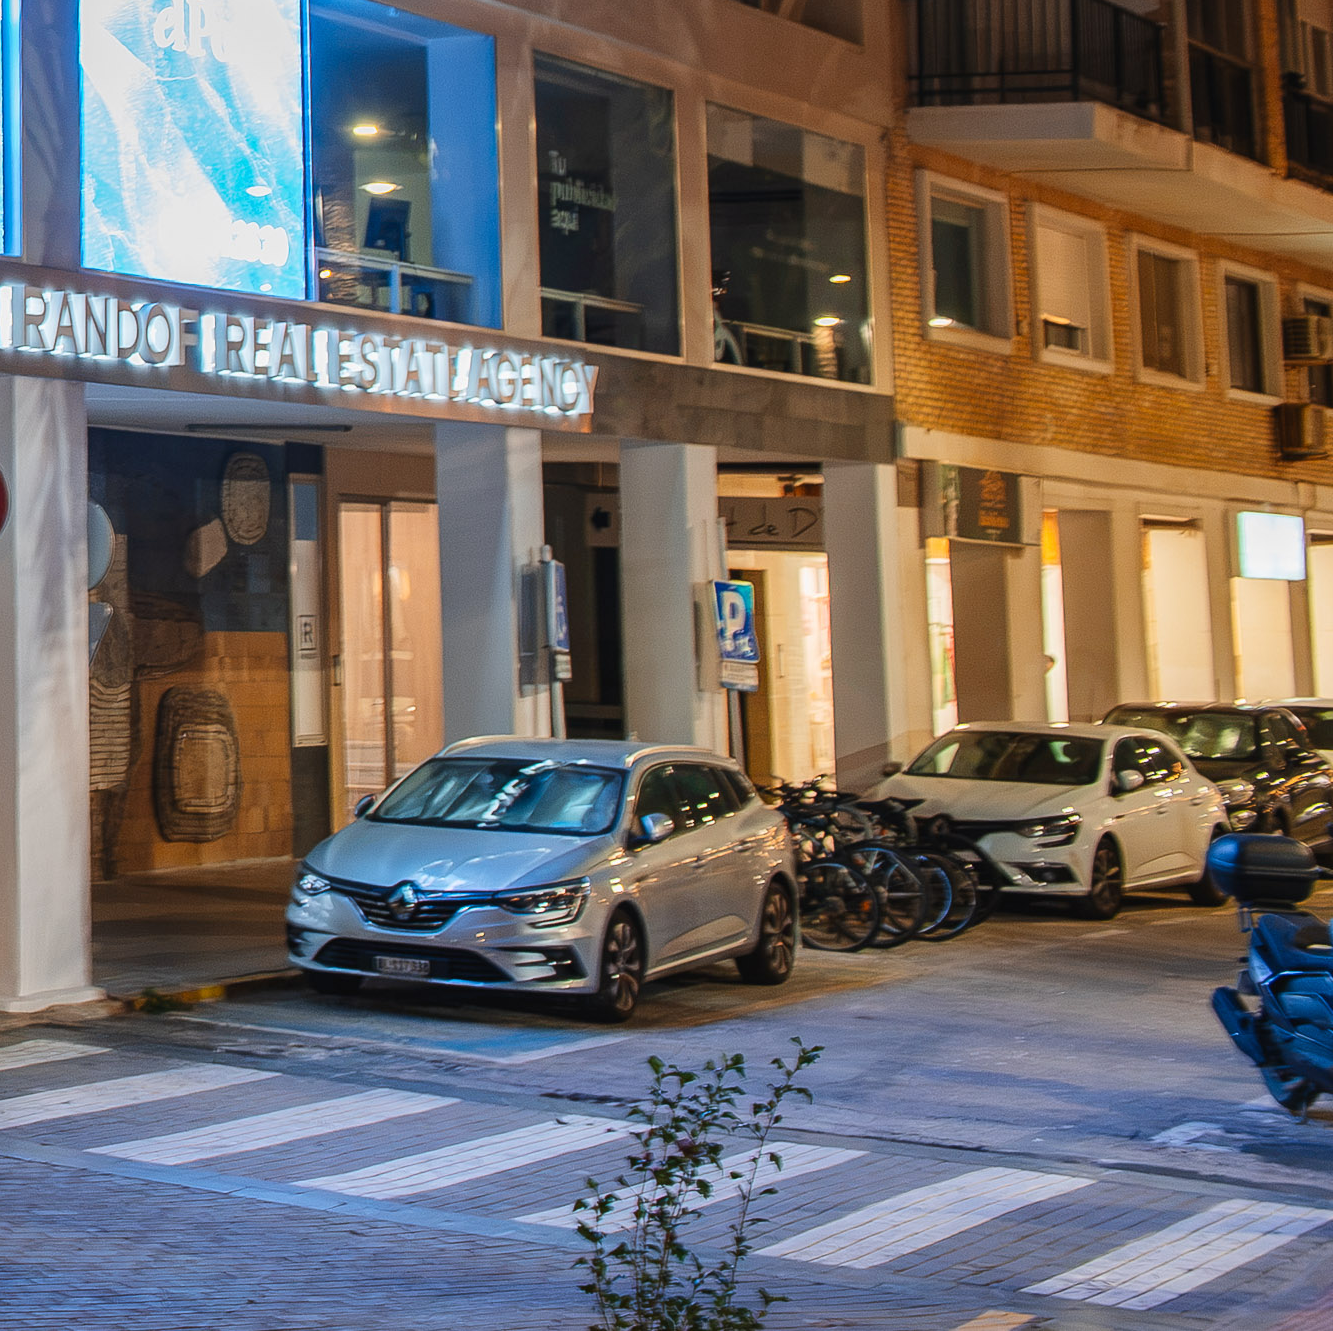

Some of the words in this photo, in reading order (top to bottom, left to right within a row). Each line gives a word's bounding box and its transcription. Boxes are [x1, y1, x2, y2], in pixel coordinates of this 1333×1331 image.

[13, 284, 199, 367] RANDOF
[216, 314, 312, 381] REAL
[328, 329, 459, 398] ESTATE
[467, 348, 599, 414] AGENCY
[719, 590, 747, 635] P
